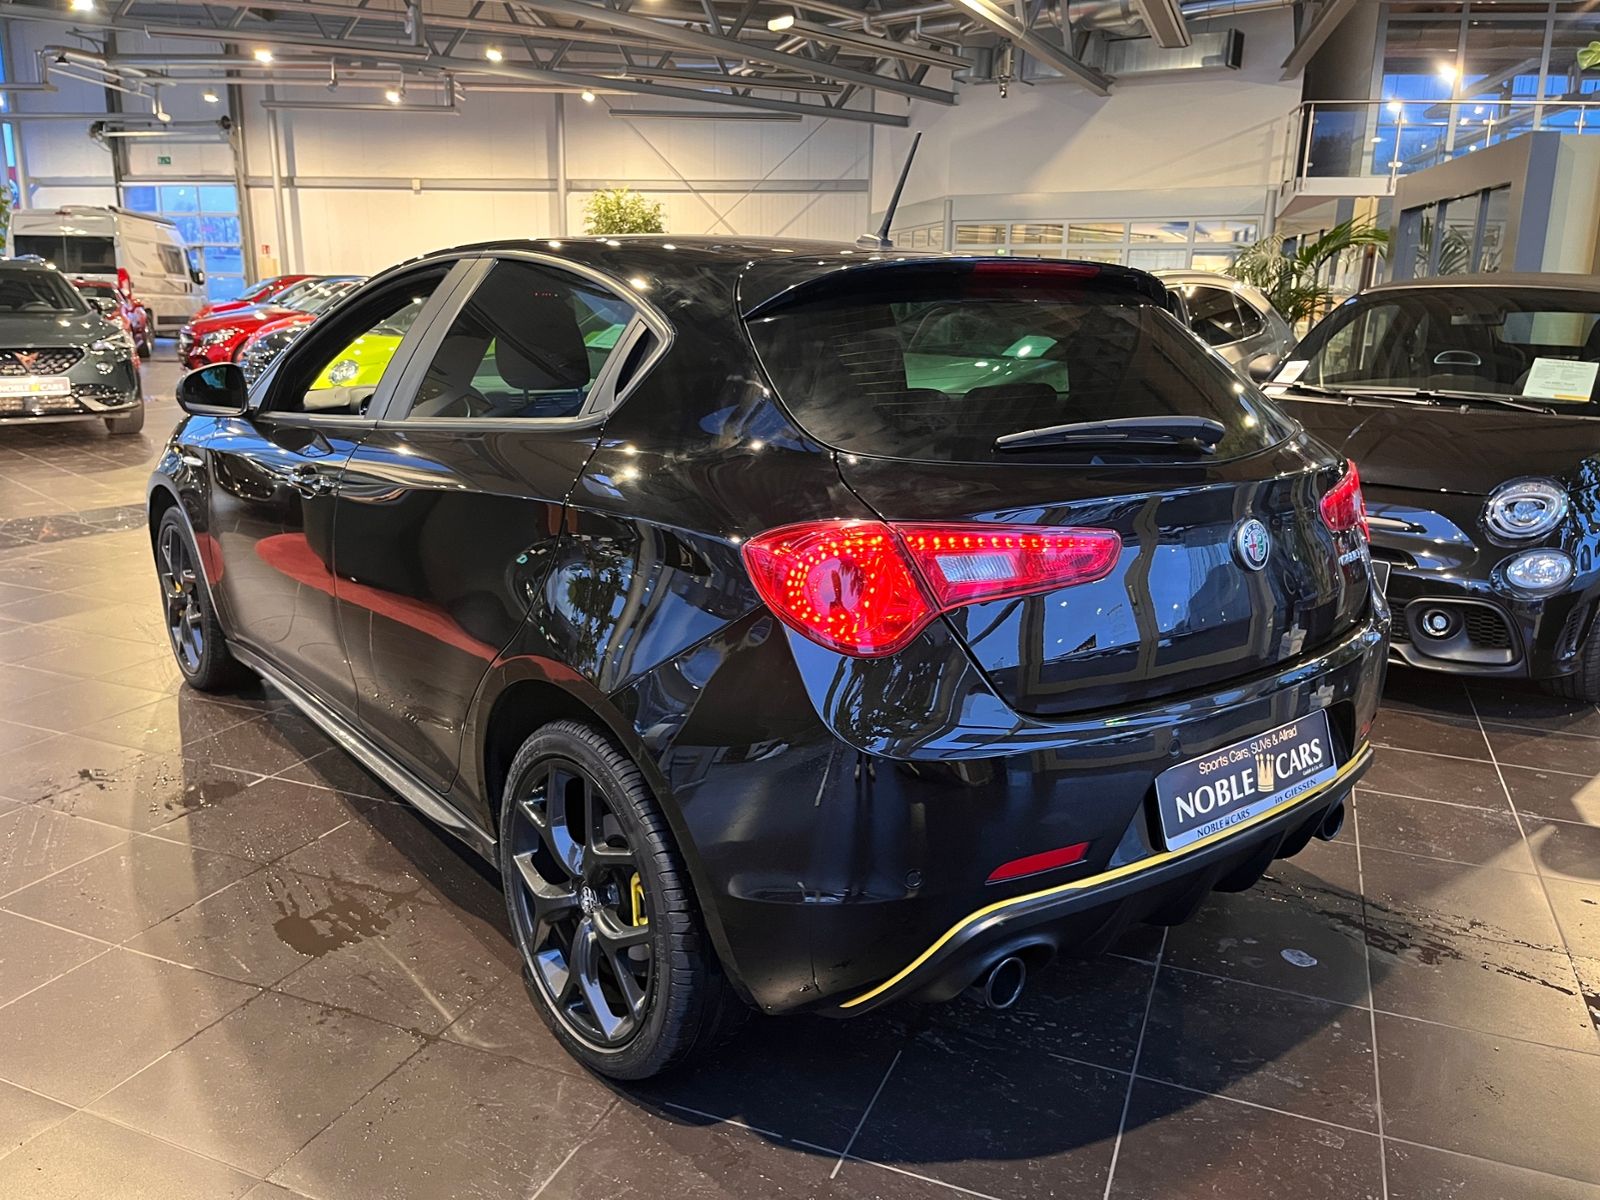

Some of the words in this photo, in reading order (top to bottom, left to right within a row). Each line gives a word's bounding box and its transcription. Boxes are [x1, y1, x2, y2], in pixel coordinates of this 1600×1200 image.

[1199, 755, 1229, 775] Sports
[1229, 748, 1251, 763] Cars,
[1250, 737, 1271, 754] SUVs
[1272, 734, 1278, 745] &
[1279, 725, 1297, 743] Allrad
[1175, 768, 1255, 823] NOBLE
[1275, 738, 1322, 779] CARS
[1196, 820, 1224, 838] NOBLE
[1230, 808, 1251, 824] CARS
[1274, 795, 1283, 804] in
[1284, 778, 1317, 799] GIESSEN
